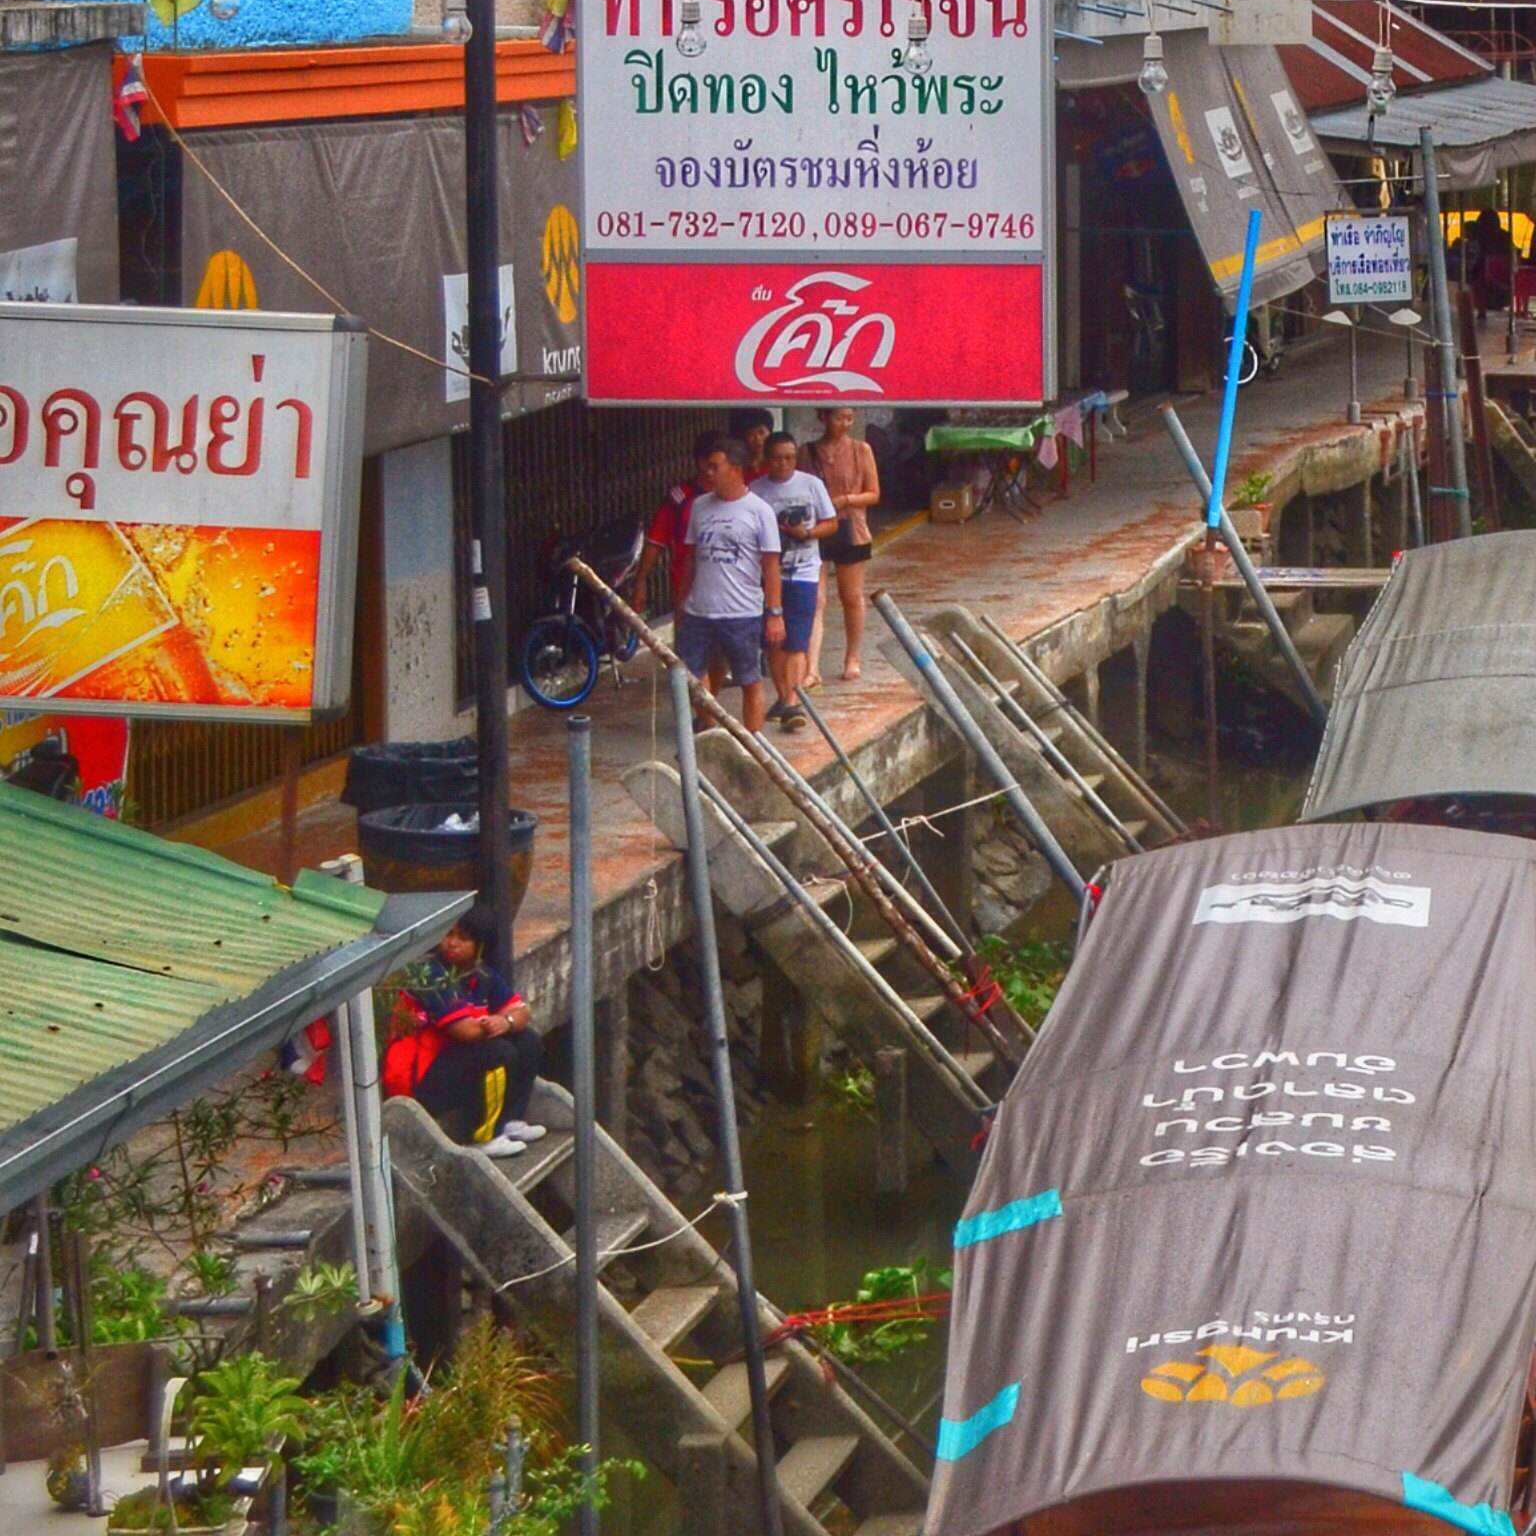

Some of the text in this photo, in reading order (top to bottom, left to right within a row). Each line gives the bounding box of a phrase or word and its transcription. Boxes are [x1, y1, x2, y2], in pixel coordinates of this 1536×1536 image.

[624, 46, 1004, 115] ปิดทอง ไหว้พระ
[655, 124, 977, 189] จองบัตรชมหิ่งห้อย
[1173, 1051, 1397, 1075] อัมพวา
[1154, 1112, 1392, 1137] ชมสวน
[1125, 1319, 1355, 1354] krungsri
